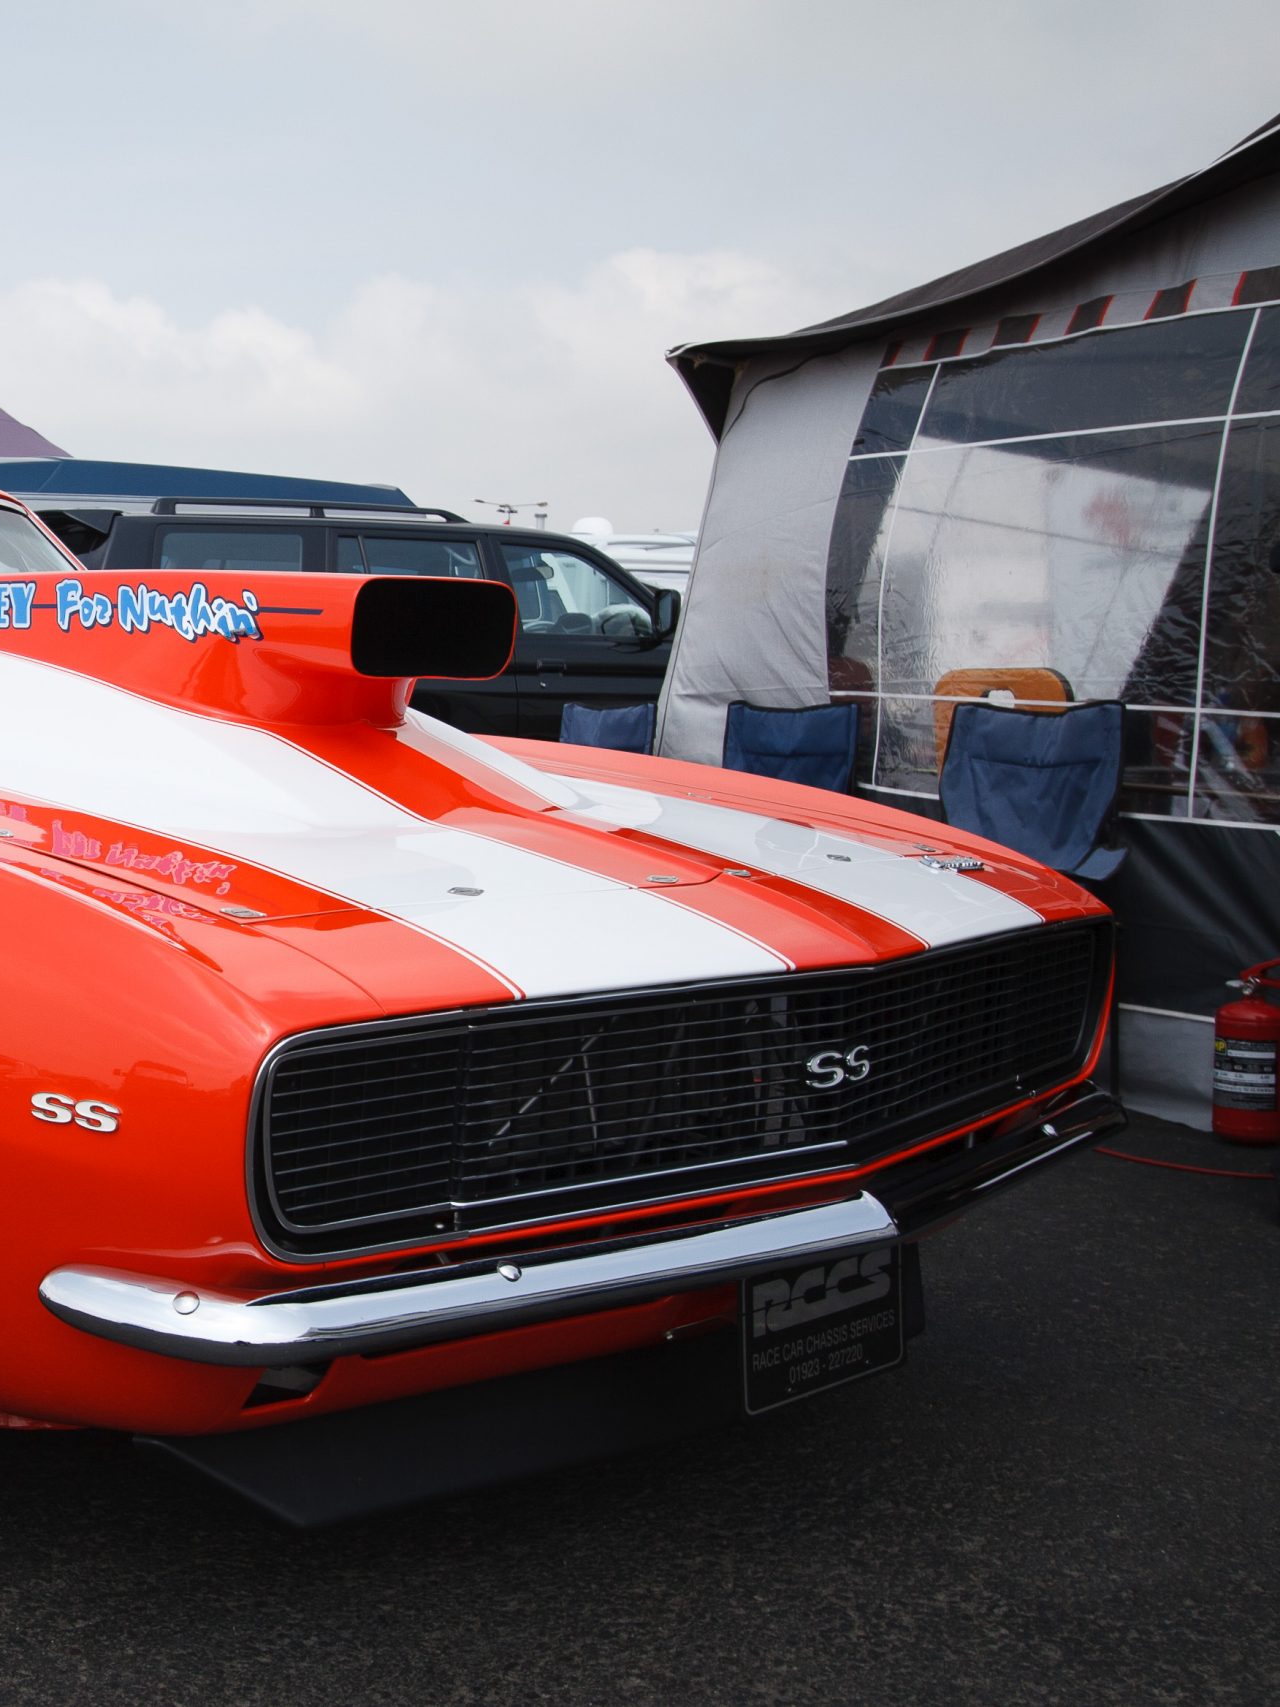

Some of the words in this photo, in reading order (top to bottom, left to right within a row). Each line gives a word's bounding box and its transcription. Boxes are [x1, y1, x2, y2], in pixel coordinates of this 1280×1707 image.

[55, 578, 113, 632] For
[117, 582, 262, 643] Nuthin'
[805, 1044, 870, 1089] SS
[30, 1091, 121, 1133] SS
[752, 1346, 781, 1373] RACE
[782, 1338, 804, 1362] CAR
[805, 1325, 848, 1356] CHASSIS
[850, 1308, 896, 1341] SERVICES
[788, 1358, 821, 1385] 01923
[828, 1343, 864, 1371] 227220
